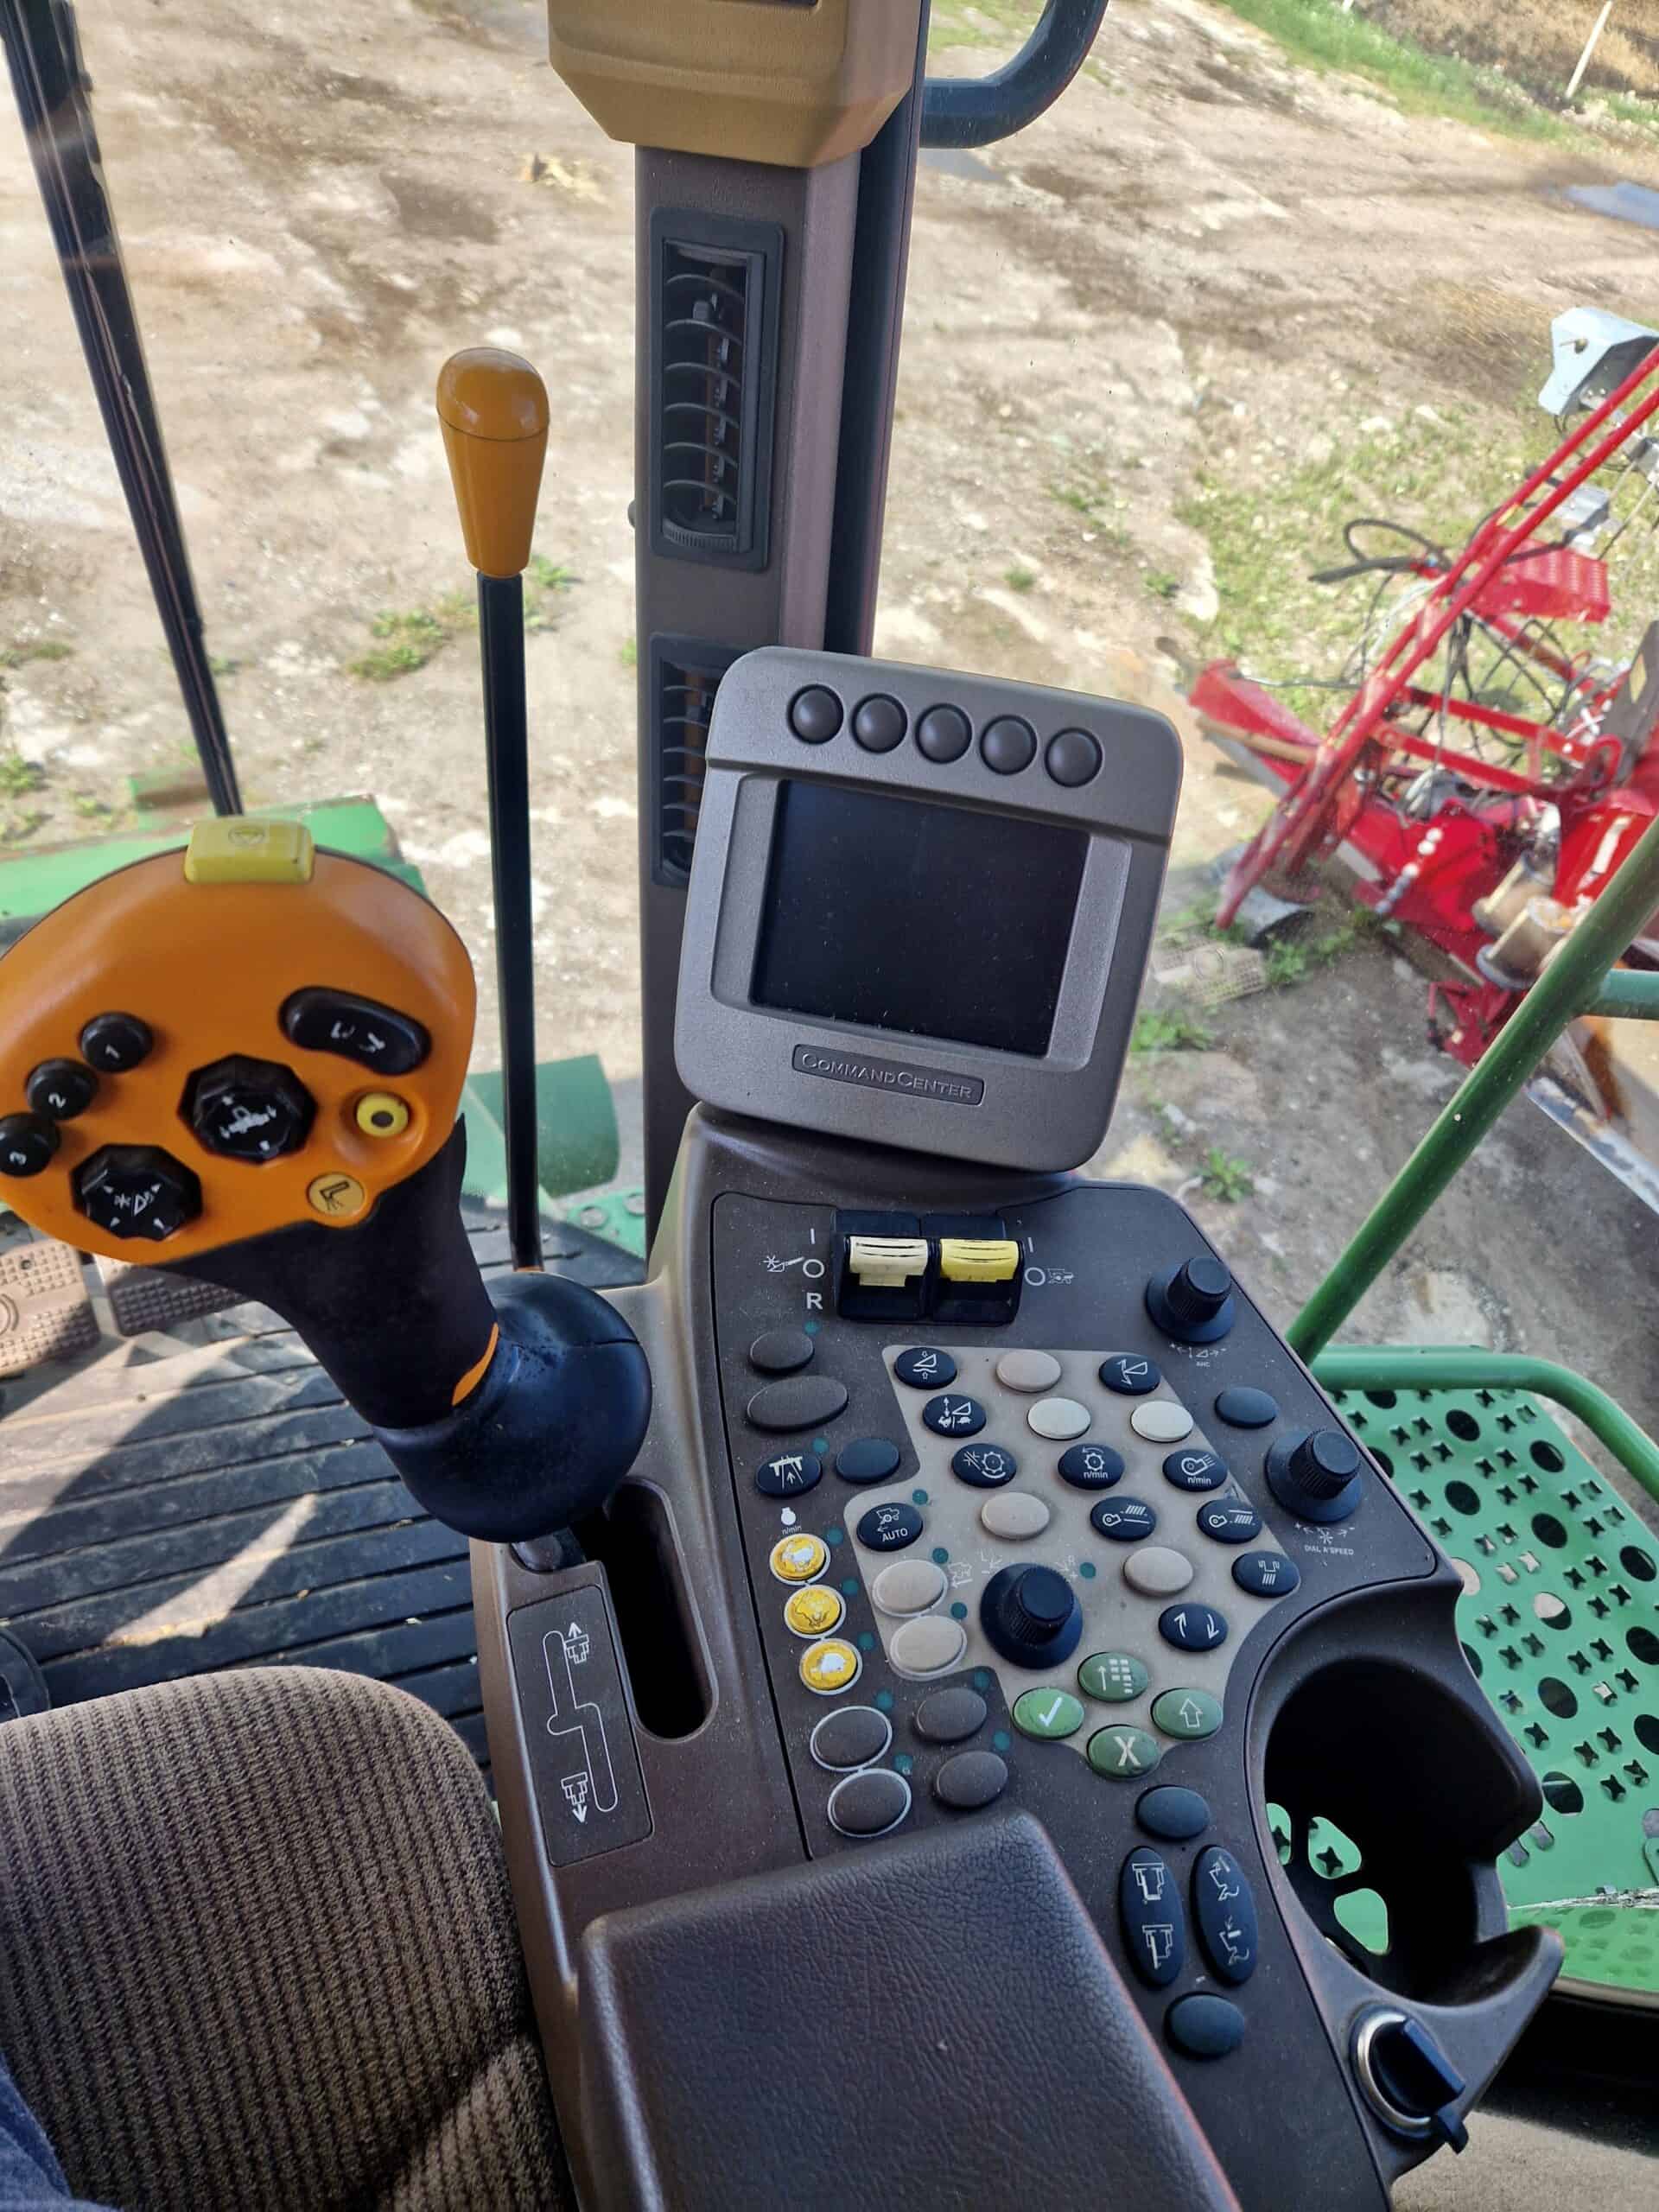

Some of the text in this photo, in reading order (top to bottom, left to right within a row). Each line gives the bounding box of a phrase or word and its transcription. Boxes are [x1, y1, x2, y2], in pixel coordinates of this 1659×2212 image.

[105, 1044, 120, 1058] 1
[48, 1092, 67, 1109] 2
[9, 1150, 28, 1166] 3
[806, 1292, 823, 1310] R
[1083, 1471, 1109, 1479] n/min
[1187, 1477, 1212, 1485] n/min
[781, 1524, 803, 1535] n/min
[881, 1527, 909, 1542] AUTO
[1113, 1735, 1141, 1767] X
